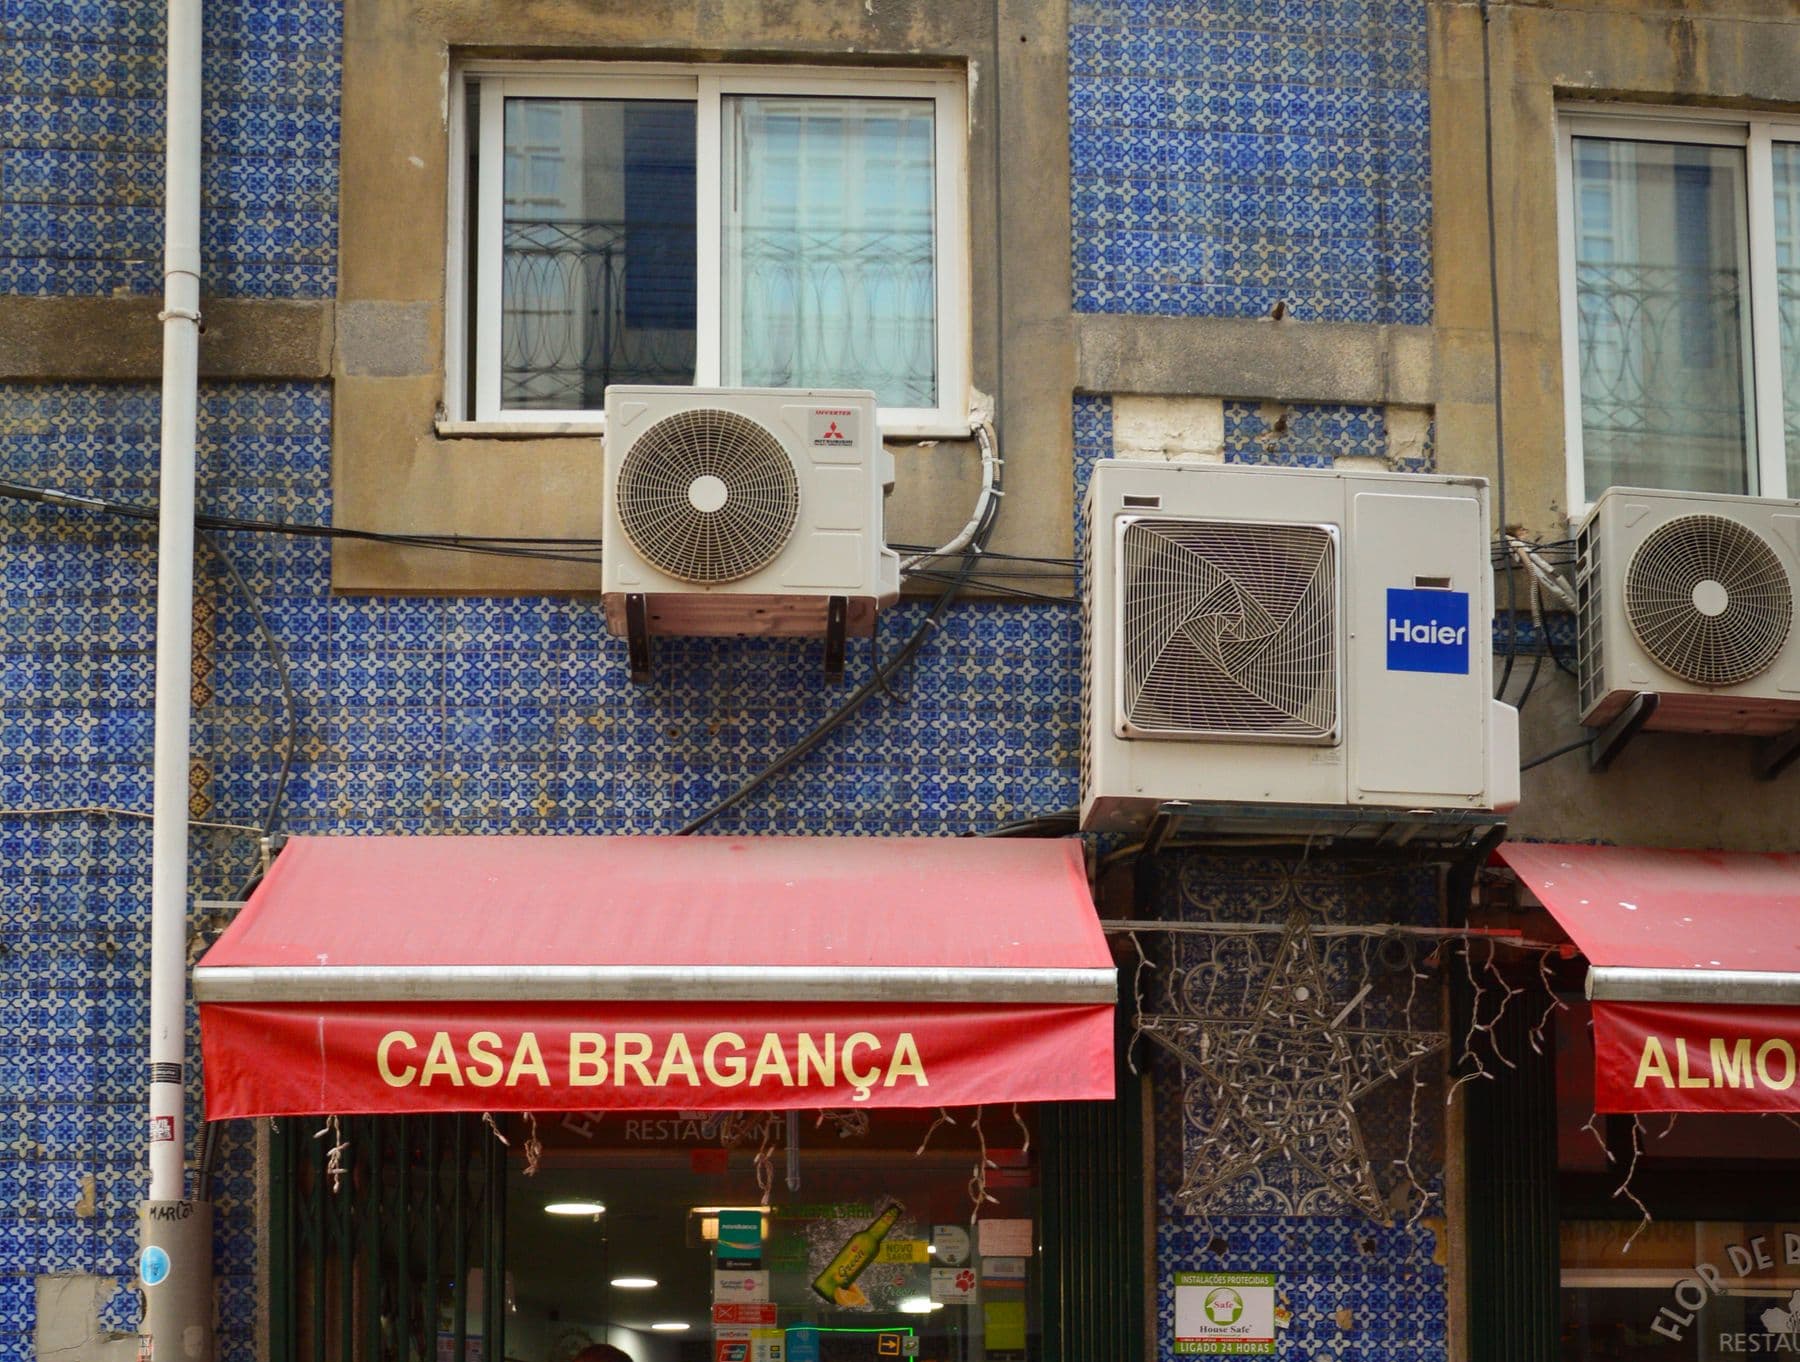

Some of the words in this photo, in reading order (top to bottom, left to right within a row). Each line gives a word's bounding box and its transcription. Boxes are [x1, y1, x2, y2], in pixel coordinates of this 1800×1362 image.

[1389, 618, 1467, 646] Haier
[377, 1030, 551, 1088] CASA
[568, 1031, 930, 1106] BRAGANÇA
[1633, 1035, 1798, 1091] ALMO
[1180, 1273, 1226, 1286] INSTALAÇÕES
[1226, 1275, 1270, 1285] PROTEGIDAS
[1649, 1262, 1722, 1342] FLOR
[1726, 1235, 1775, 1278] DE
[1213, 1300, 1235, 1309] Safe
[1199, 1325, 1228, 1334] House
[1229, 1325, 1250, 1334] Safe
[1180, 1343, 1218, 1353] LIGADO
[1220, 1343, 1235, 1353] 24
[1236, 1343, 1270, 1354] HORAS
